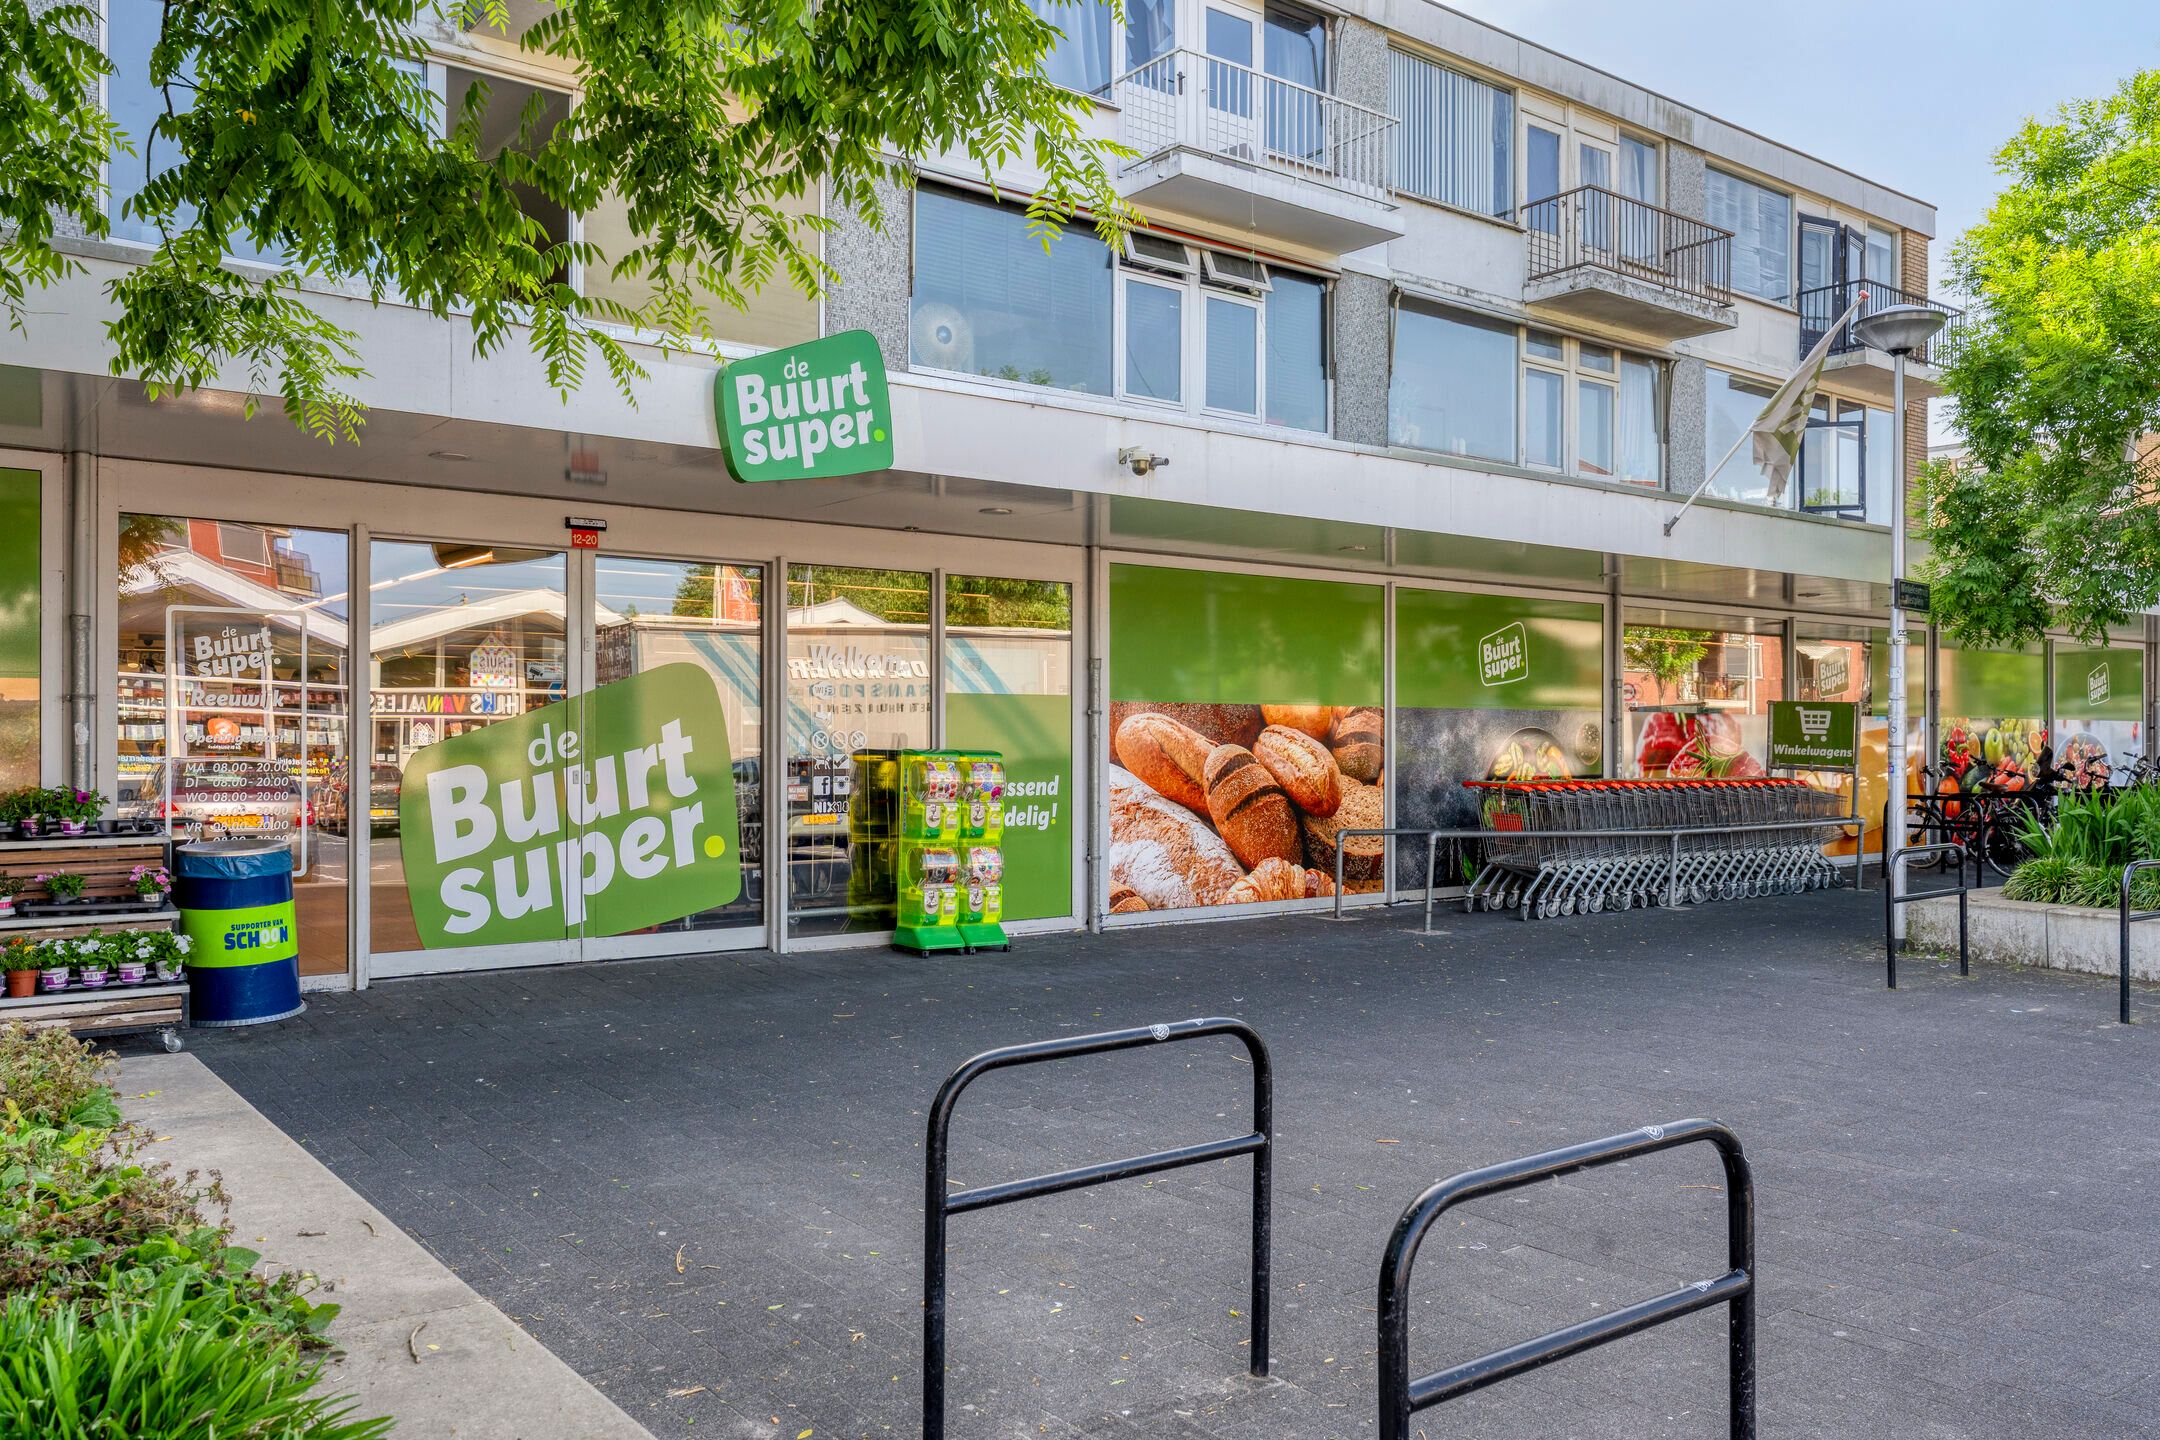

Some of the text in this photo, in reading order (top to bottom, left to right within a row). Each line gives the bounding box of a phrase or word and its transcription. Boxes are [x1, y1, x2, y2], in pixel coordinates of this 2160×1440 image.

[783, 356, 810, 379] de
[735, 361, 870, 426] Buurt
[742, 409, 886, 469] super.
[572, 534, 597, 545] 12-20
[222, 626, 237, 638] de
[194, 627, 272, 661] Buurt
[1483, 635, 1521, 664] Buurt
[197, 649, 281, 679] super.
[1484, 654, 1525, 679] super.
[191, 688, 284, 709] Reeuwijk
[528, 722, 580, 767] de
[1774, 744, 1853, 758] Winkelwagens
[185, 763, 205, 773] MA
[185, 778, 199, 788] DI
[426, 718, 699, 864] Buurt
[185, 792, 208, 802] WO
[814, 801, 850, 813] NIX18
[185, 822, 203, 832] VR
[440, 801, 726, 934] super.
[231, 918, 284, 931] SUPPORTER VAN
[224, 926, 288, 951] SCHOON
